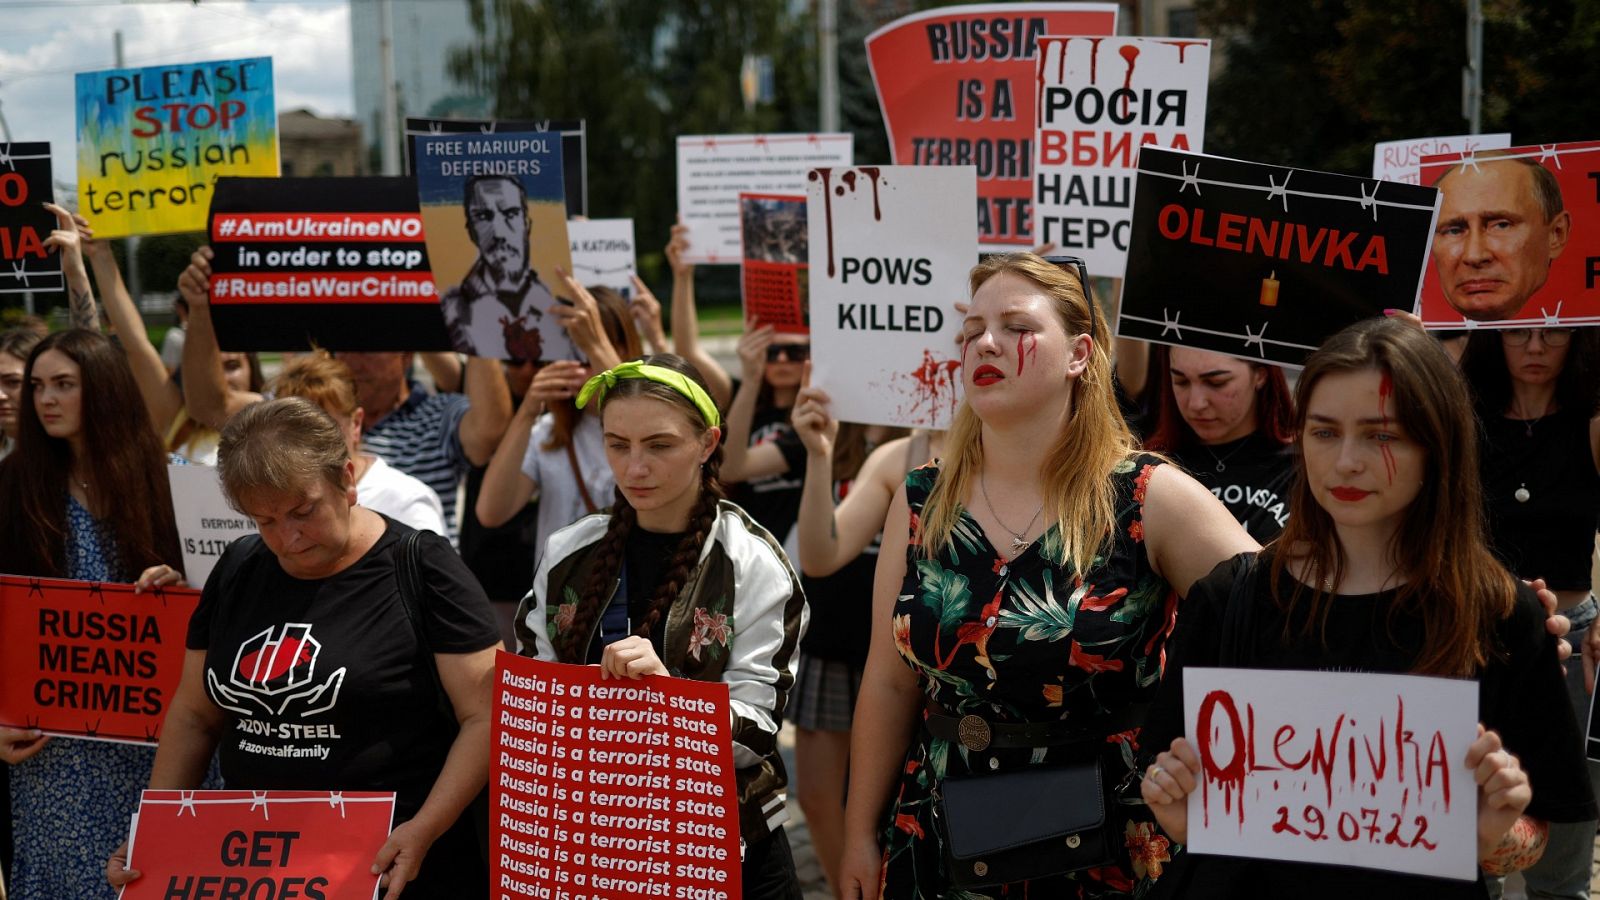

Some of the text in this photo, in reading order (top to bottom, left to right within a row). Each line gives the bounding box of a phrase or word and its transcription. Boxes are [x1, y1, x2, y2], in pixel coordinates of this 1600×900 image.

[926, 17, 1046, 62] RUSSIA
[106, 62, 259, 105] PLEASE
[957, 79, 1014, 121] IS A
[131, 100, 247, 138] STOP
[1045, 87, 1188, 127] РОСІЯ
[100, 136, 250, 177] russian
[426, 139, 550, 156] FREE MARIUPOL
[441, 159, 541, 176] DEFENDERS
[219, 217, 422, 237] #ArmUkraineNO
[1158, 203, 1389, 275] OLENIVKA
[238, 247, 422, 269] in order to stop
[841, 257, 932, 285] POWS
[215, 276, 438, 298] #RussiaWarCrime
[837, 304, 944, 333] KILLED
[201, 518, 244, 529] EVERYDAY
[184, 537, 196, 554] IS
[38, 608, 162, 644] RUSSIA
[38, 643, 157, 680] MEANS
[33, 678, 163, 716] CRIMES
[501, 669, 716, 714] Russia is a terrorist state
[236, 718, 341, 739] AZOV-STEEL
[501, 690, 718, 736] Russia is a terrorist state
[238, 739, 330, 760] #azovstalfamily
[500, 710, 720, 756] Russia is a terrorist state
[499, 730, 722, 777] Russia is a terrorist state
[499, 751, 724, 797] Russia is a terrorist state
[499, 771, 726, 818] Russia is a terrorist state
[499, 792, 727, 840] Russia is a terrorist state
[221, 830, 300, 868] GET
[499, 812, 728, 861] Russia is a terrorist state
[499, 833, 728, 883] Russia is a terrorist state
[500, 853, 728, 900] Russia is a terrorist state
[164, 876, 329, 900] HEROES
[500, 873, 551, 900] Russia
[555, 885, 570, 900] is
